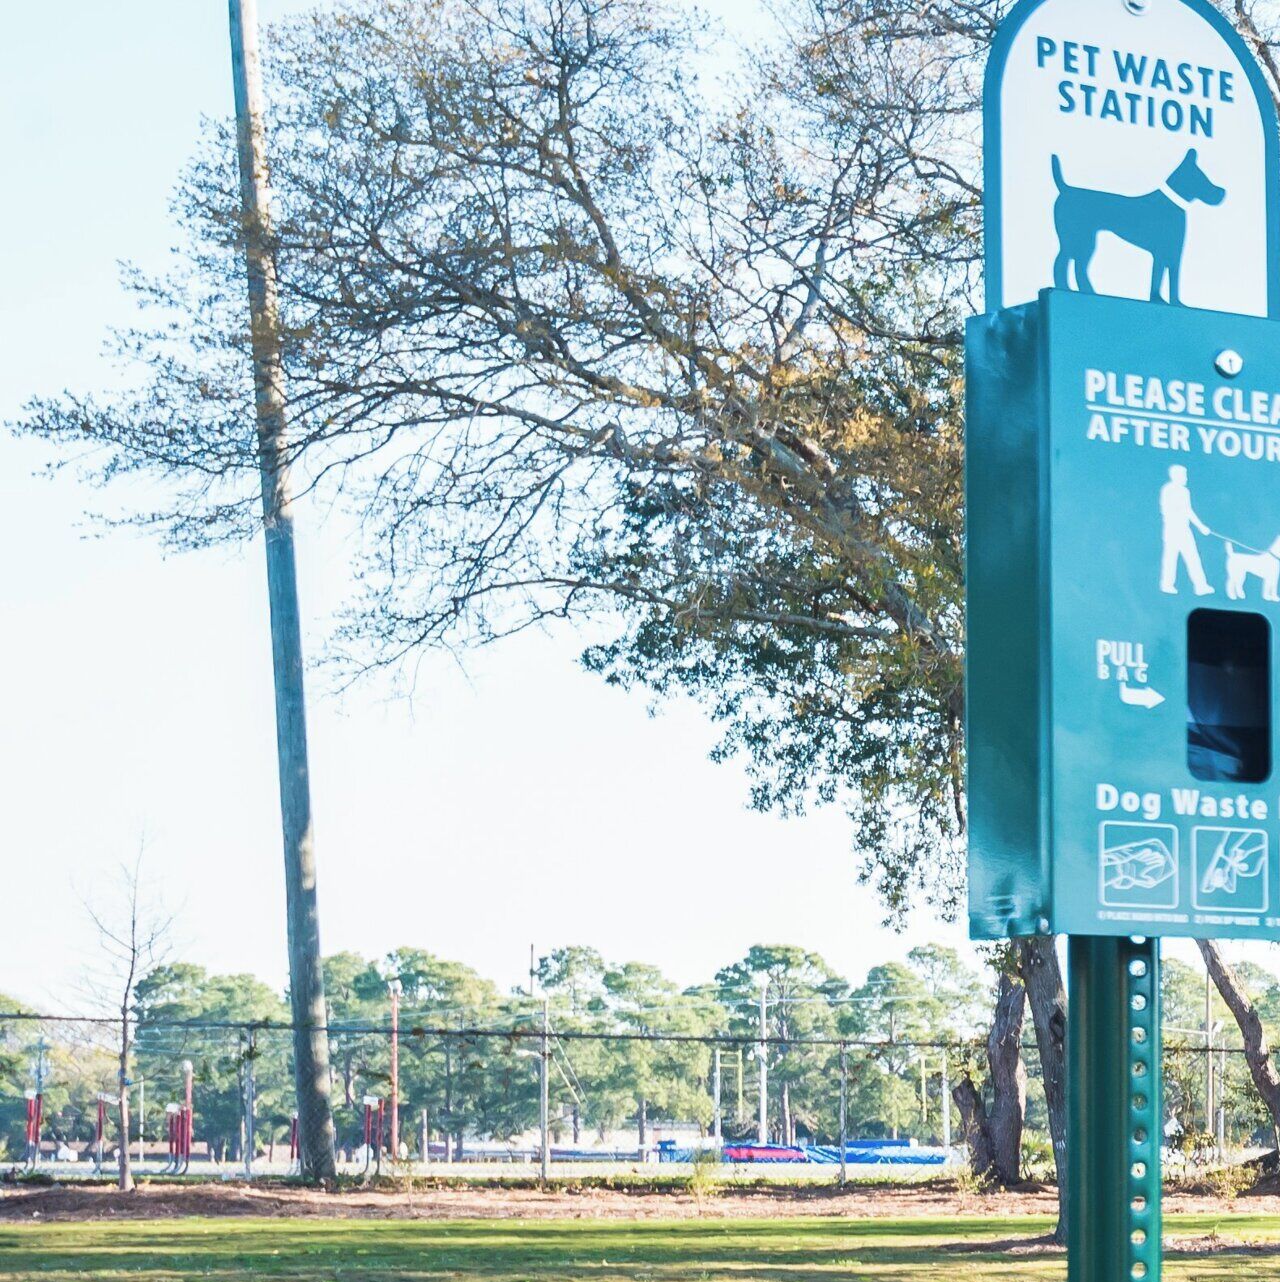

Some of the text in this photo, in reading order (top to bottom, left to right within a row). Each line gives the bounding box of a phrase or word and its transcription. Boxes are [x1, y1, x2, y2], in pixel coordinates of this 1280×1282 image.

[1036, 36, 1235, 104] PET WASTE
[1058, 80, 1215, 138] STATION
[1084, 368, 1207, 417] PLEASE
[1086, 414, 1190, 452] AFTER
[1096, 639, 1148, 668] PULL
[1096, 783, 1161, 820] Dog
[1171, 788, 1269, 821] Waste
